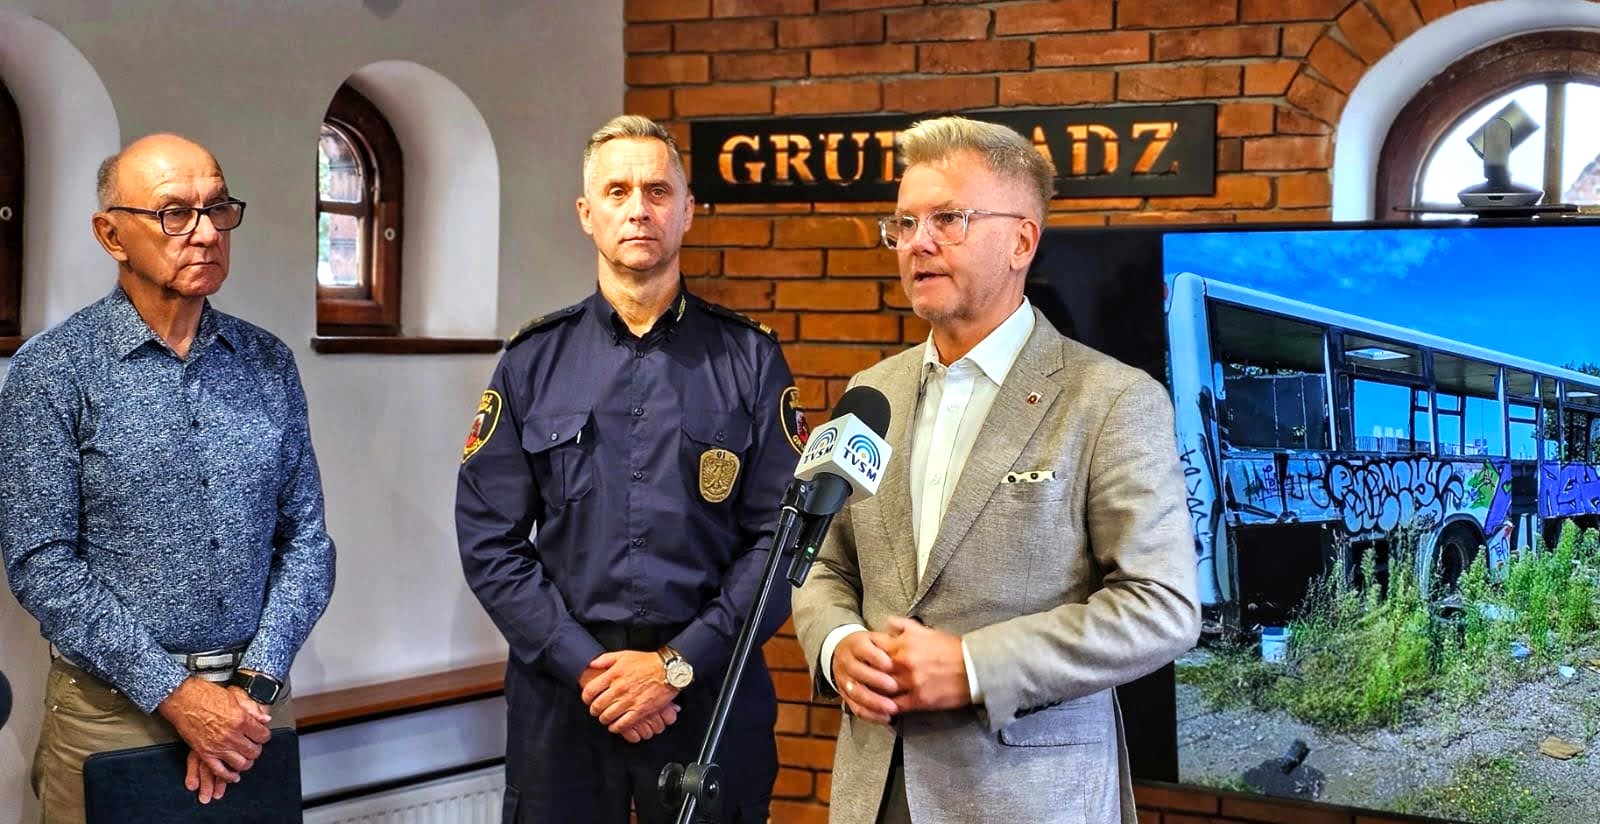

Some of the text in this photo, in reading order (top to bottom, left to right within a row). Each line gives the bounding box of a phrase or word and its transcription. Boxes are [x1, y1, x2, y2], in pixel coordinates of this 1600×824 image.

[717, 121, 1179, 185] GRUDZ
[803, 444, 834, 465] TVSM
[843, 447, 877, 482] TVSM
